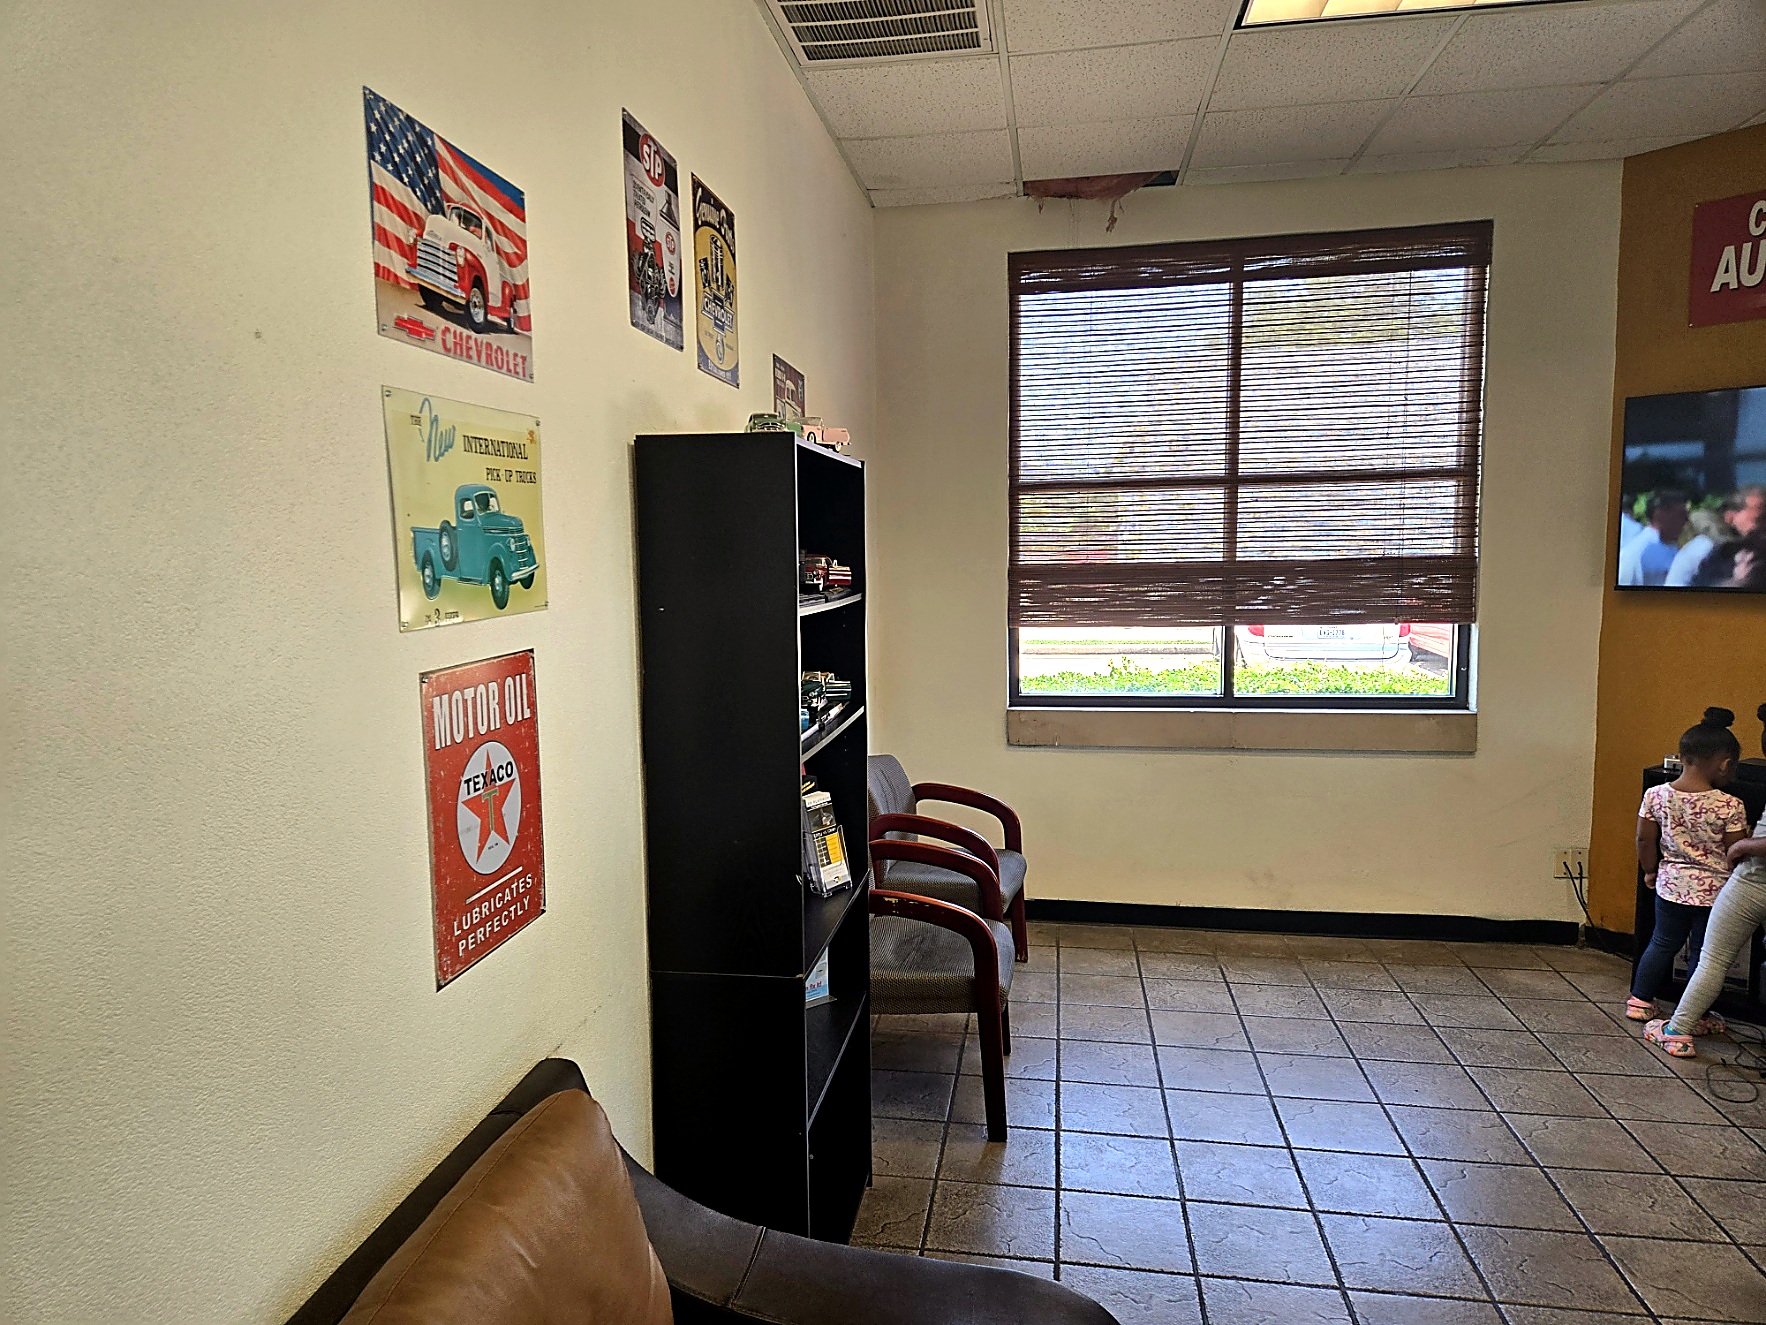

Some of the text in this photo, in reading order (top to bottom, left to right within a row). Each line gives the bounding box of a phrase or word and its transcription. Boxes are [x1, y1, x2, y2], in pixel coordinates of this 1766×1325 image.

[643, 138, 662, 180] STP
[704, 298, 733, 328] CHEVROLET
[441, 325, 527, 379] CHEVROLET
[418, 397, 456, 462] New
[462, 434, 528, 460] INTERNATIONAL
[515, 470, 537, 484] TRUCKS
[433, 673, 531, 750] MOTOR OIL
[464, 760, 514, 796] TEXACO
[481, 788, 499, 833] T
[453, 873, 532, 936] LUBRICATES
[458, 895, 530, 957] PERFECTLY
